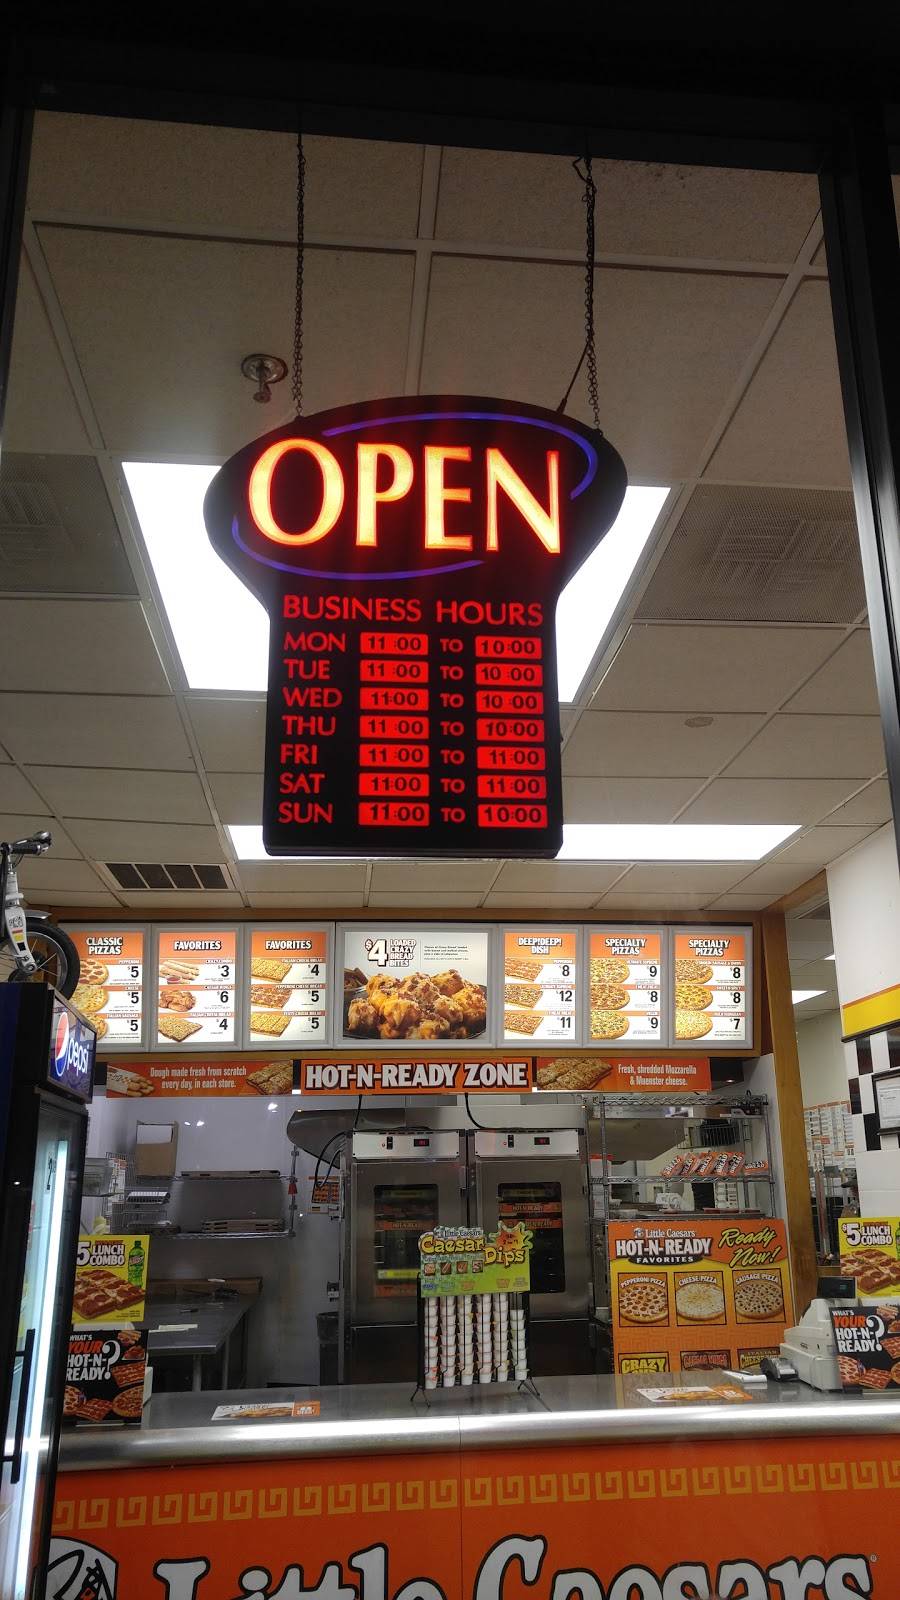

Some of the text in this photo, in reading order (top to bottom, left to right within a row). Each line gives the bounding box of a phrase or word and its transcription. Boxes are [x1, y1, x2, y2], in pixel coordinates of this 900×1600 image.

[249, 438, 561, 554] OPEN
[283, 594, 544, 627] BUSINESS HOURS
[283, 631, 535, 655] MON 11:00 TO 10:00
[283, 659, 535, 682] TUE 11:00 TO 10:00
[282, 687, 538, 709] WED 11:00 TO 10:00
[282, 715, 539, 737] THU 11:00 TO 10:00
[280, 743, 540, 765] FRI 11:00 TO 11:00
[279, 772, 541, 794] SAT 11:00 TO 11:00
[278, 801, 542, 824] SUN 11:00 TO 10:00
[86, 937, 123, 946] CLASSIC
[174, 940, 222, 950] FAVORITES
[265, 940, 312, 950] FAVORITES
[605, 938, 646, 947] SPECIALTY
[688, 939, 730, 948] SPECIALTY
[88, 946, 122, 955] PIZZAS
[365, 938, 388, 967] $4
[531, 946, 549, 954] DISH
[612, 947, 640, 955] PIZZAS
[695, 948, 724, 956] PIZZAS
[67, 1037, 90, 1077] pepsi
[150, 1067, 246, 1079] Dough made fresh from scratch
[305, 1062, 529, 1089] HOT-N-READY ZONE
[618, 1064, 697, 1075] Fresh, shredded Mozzarella
[162, 1078, 236, 1090] every day, in each store.
[630, 1076, 688, 1086] & Muenster cheese.
[646, 1228, 696, 1238] Little Caesars
[718, 1226, 777, 1248] Ready
[861, 1226, 891, 1236] LUNCH
[420, 1235, 486, 1254] Caesar
[861, 1235, 893, 1246] COMBO
[92, 1244, 125, 1256] LUNCH
[616, 1238, 712, 1257] HOT-N-READY
[90, 1255, 125, 1267] COMBO
[484, 1247, 526, 1269] Dips
[636, 1256, 694, 1264] FAVORITES
[729, 1246, 782, 1268] Now!
[620, 1277, 666, 1288] PEPPERONI PIZZA
[679, 1276, 717, 1286] CHEESE PIZZA
[735, 1273, 779, 1284] SAUSAGE PIZZA
[833, 1316, 866, 1328] YOUR
[835, 1327, 875, 1340] HOT-N-
[68, 1341, 103, 1354] YOUR
[621, 1358, 667, 1372] CRAZY
